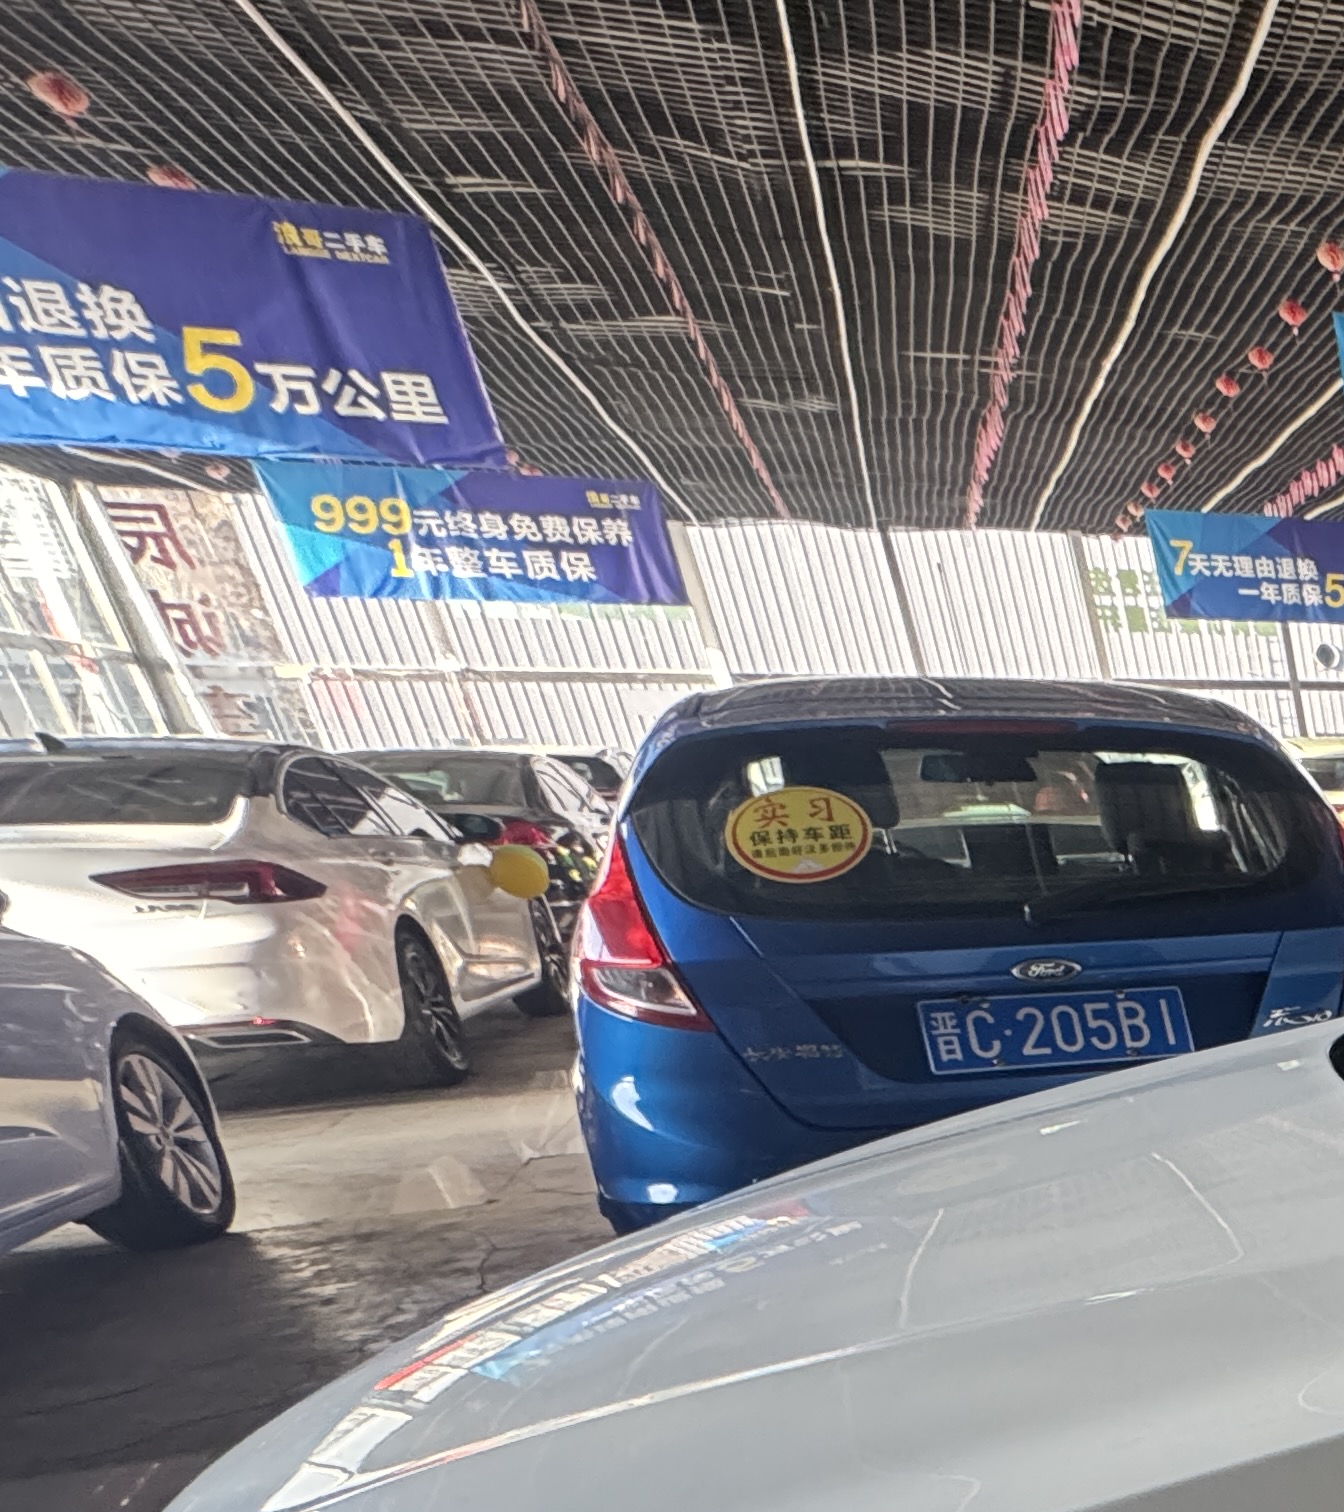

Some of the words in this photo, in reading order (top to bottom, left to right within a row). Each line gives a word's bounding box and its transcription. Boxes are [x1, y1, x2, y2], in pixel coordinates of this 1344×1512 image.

[0, 276, 156, 343] 退换
[311, 494, 634, 547] 999元终身免费保养
[389, 540, 597, 582] 1年整车质保
[1169, 540, 1319, 581] 7天无理由退换
[753, 796, 834, 828] 实习
[750, 824, 852, 846] 保持车距
[1027, 962, 1067, 977] Ford
